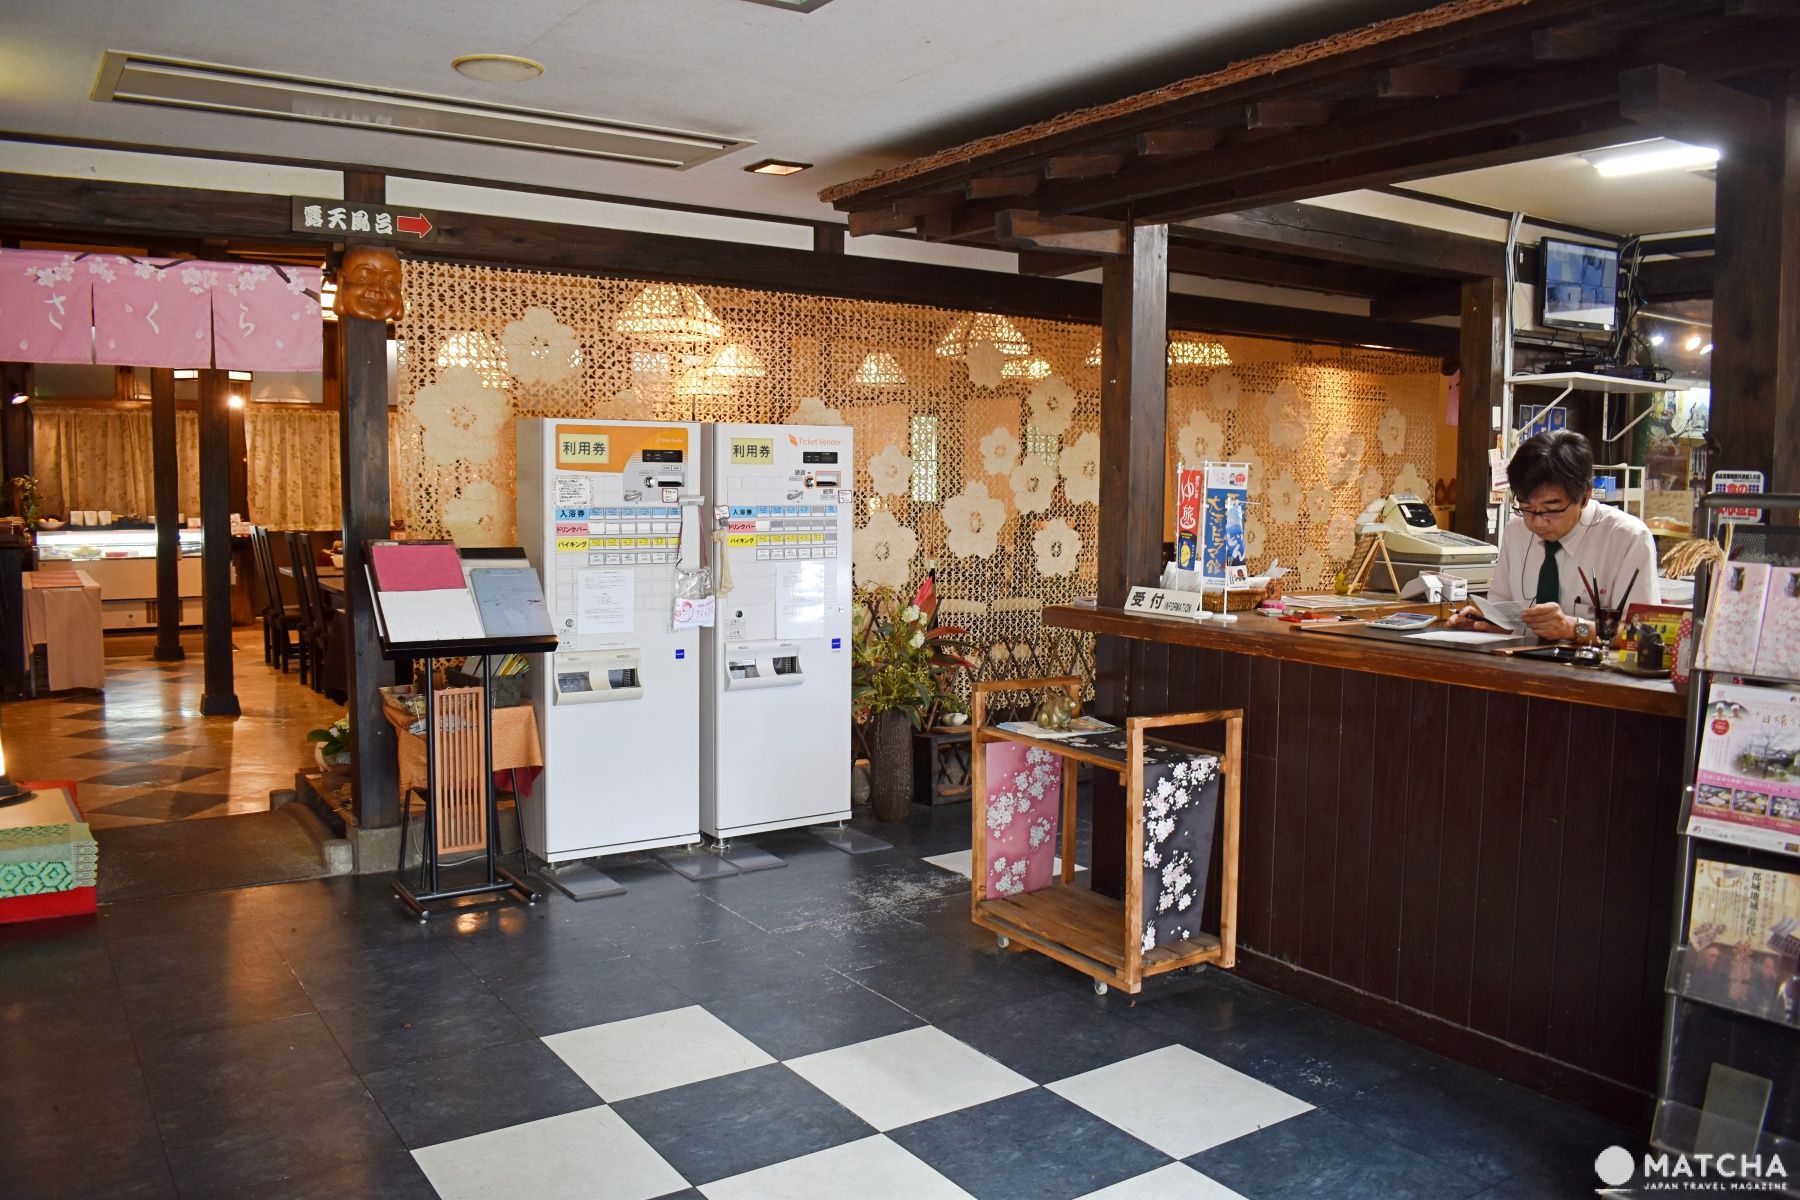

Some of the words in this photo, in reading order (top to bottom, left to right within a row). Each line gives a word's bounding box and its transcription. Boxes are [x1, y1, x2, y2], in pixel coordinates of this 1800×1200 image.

[304, 205, 392, 235] 露天風呂
[799, 437, 818, 446] Ticket
[819, 438, 841, 446] Vender
[563, 441, 606, 456] 利用券
[733, 444, 771, 458] 利用券
[560, 509, 585, 518] 入浴券
[732, 508, 753, 516] 入浴券
[556, 525, 588, 533] ドリンクバー
[728, 523, 756, 531] ドリンクバー
[1131, 591, 1165, 609] 受付
